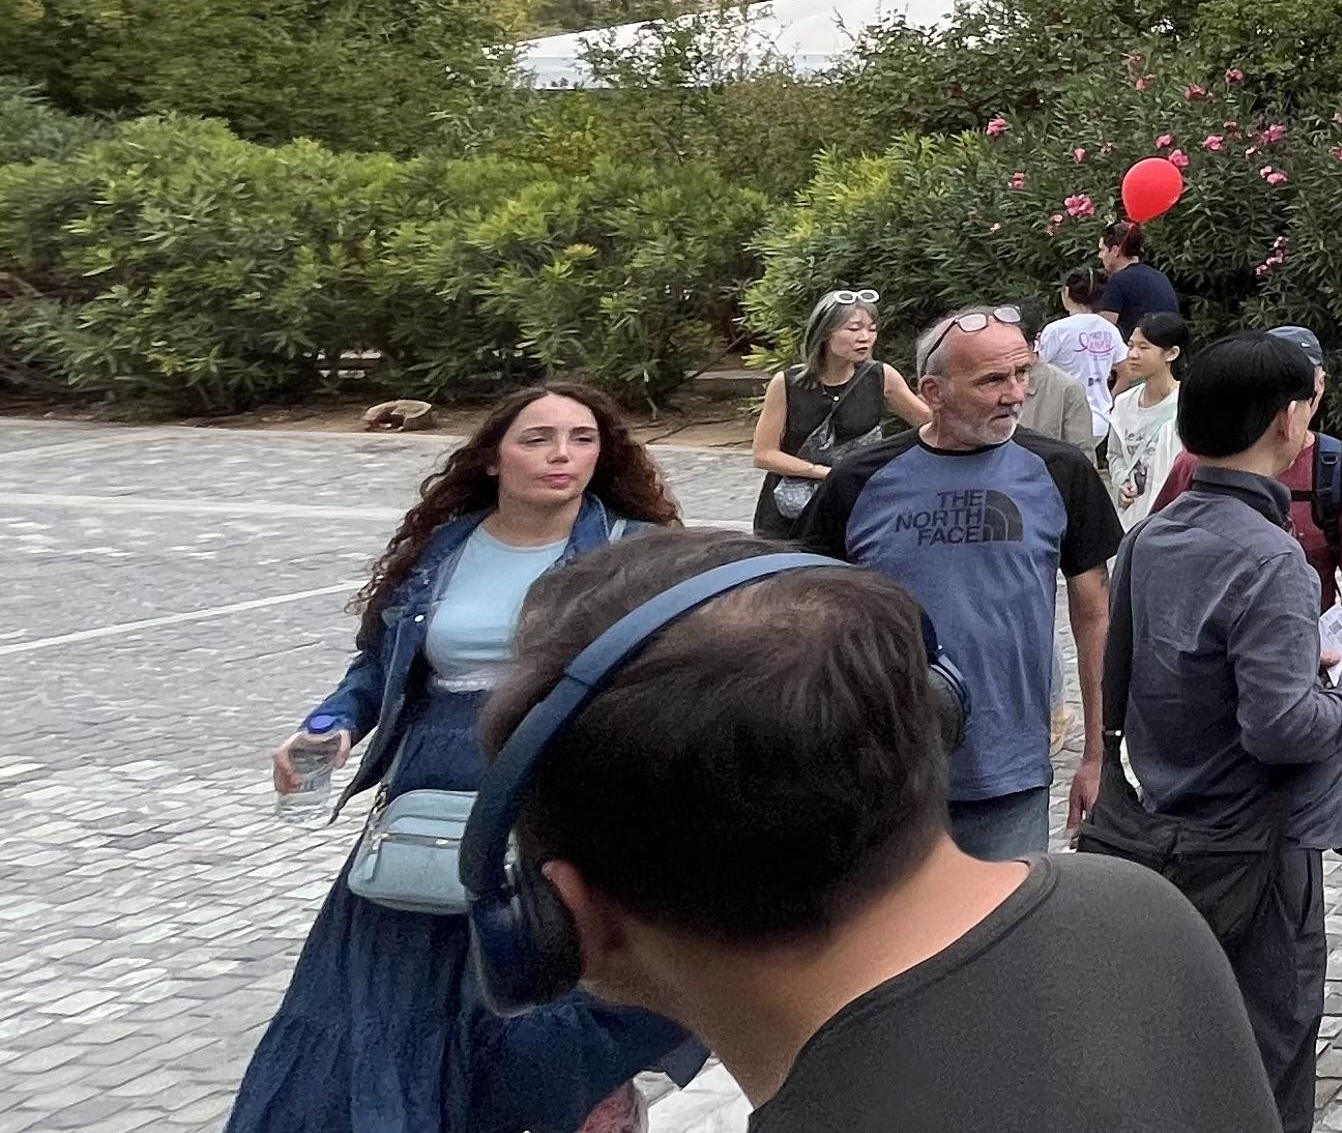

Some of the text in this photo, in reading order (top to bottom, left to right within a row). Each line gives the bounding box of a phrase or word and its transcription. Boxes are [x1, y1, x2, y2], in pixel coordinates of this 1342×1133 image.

[935, 489, 983, 508] THE
[895, 509, 981, 532] NORTH
[917, 526, 980, 546] FACE
